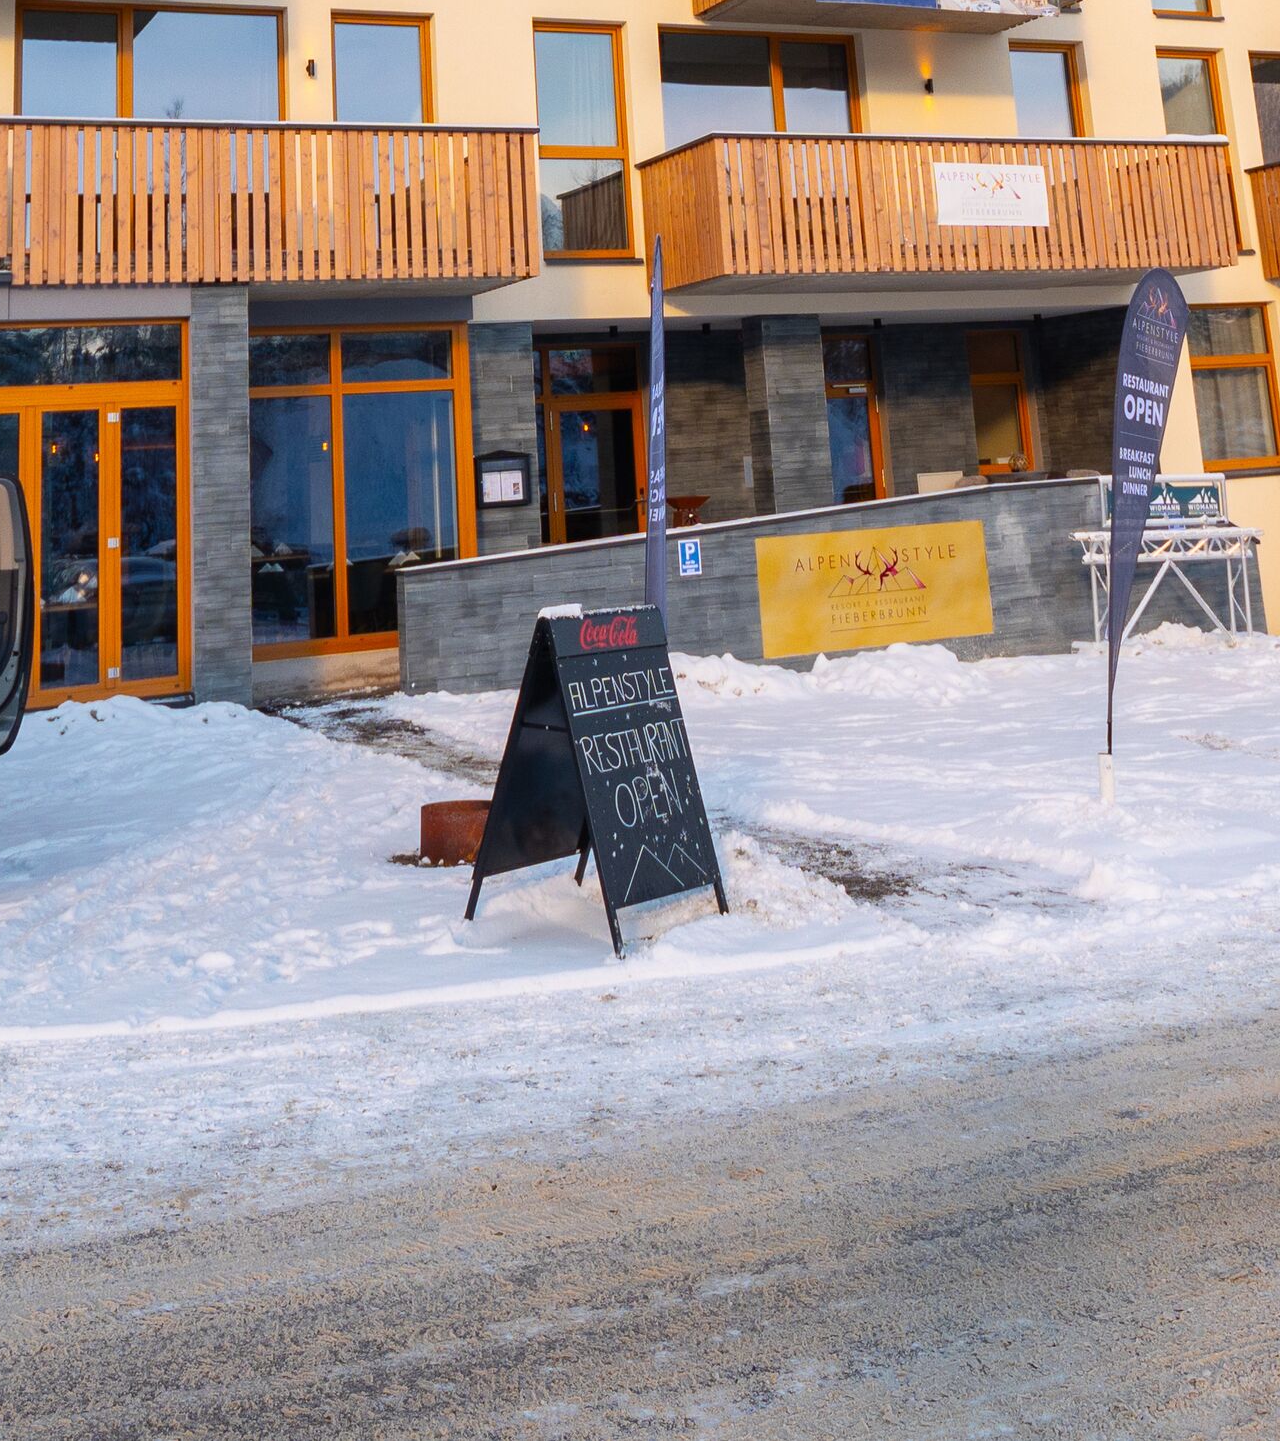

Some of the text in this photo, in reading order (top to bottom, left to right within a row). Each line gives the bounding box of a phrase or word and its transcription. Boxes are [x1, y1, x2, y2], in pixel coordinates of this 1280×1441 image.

[940, 171, 1041, 183] ALPEN STYLE
[1132, 318, 1179, 344] ALPENSTYLE
[1122, 373, 1169, 398] RESTAURANT
[1124, 394, 1164, 427] OPEN
[1120, 447, 1155, 465] BREAKFAST
[1129, 466, 1152, 481] LUNCH
[1122, 481, 1148, 497] DINNER
[1149, 504, 1180, 512] WIDMANN
[1188, 503, 1219, 511] WIDMANN
[795, 543, 958, 573] ALPEN STYLE
[875, 594, 926, 606] RESTAURANT
[831, 605, 927, 625] FIEBERBRUNN
[568, 667, 674, 711] ALPENSTYLE
[578, 718, 688, 775] RESTAURANT
[615, 768, 683, 827] OPEN
